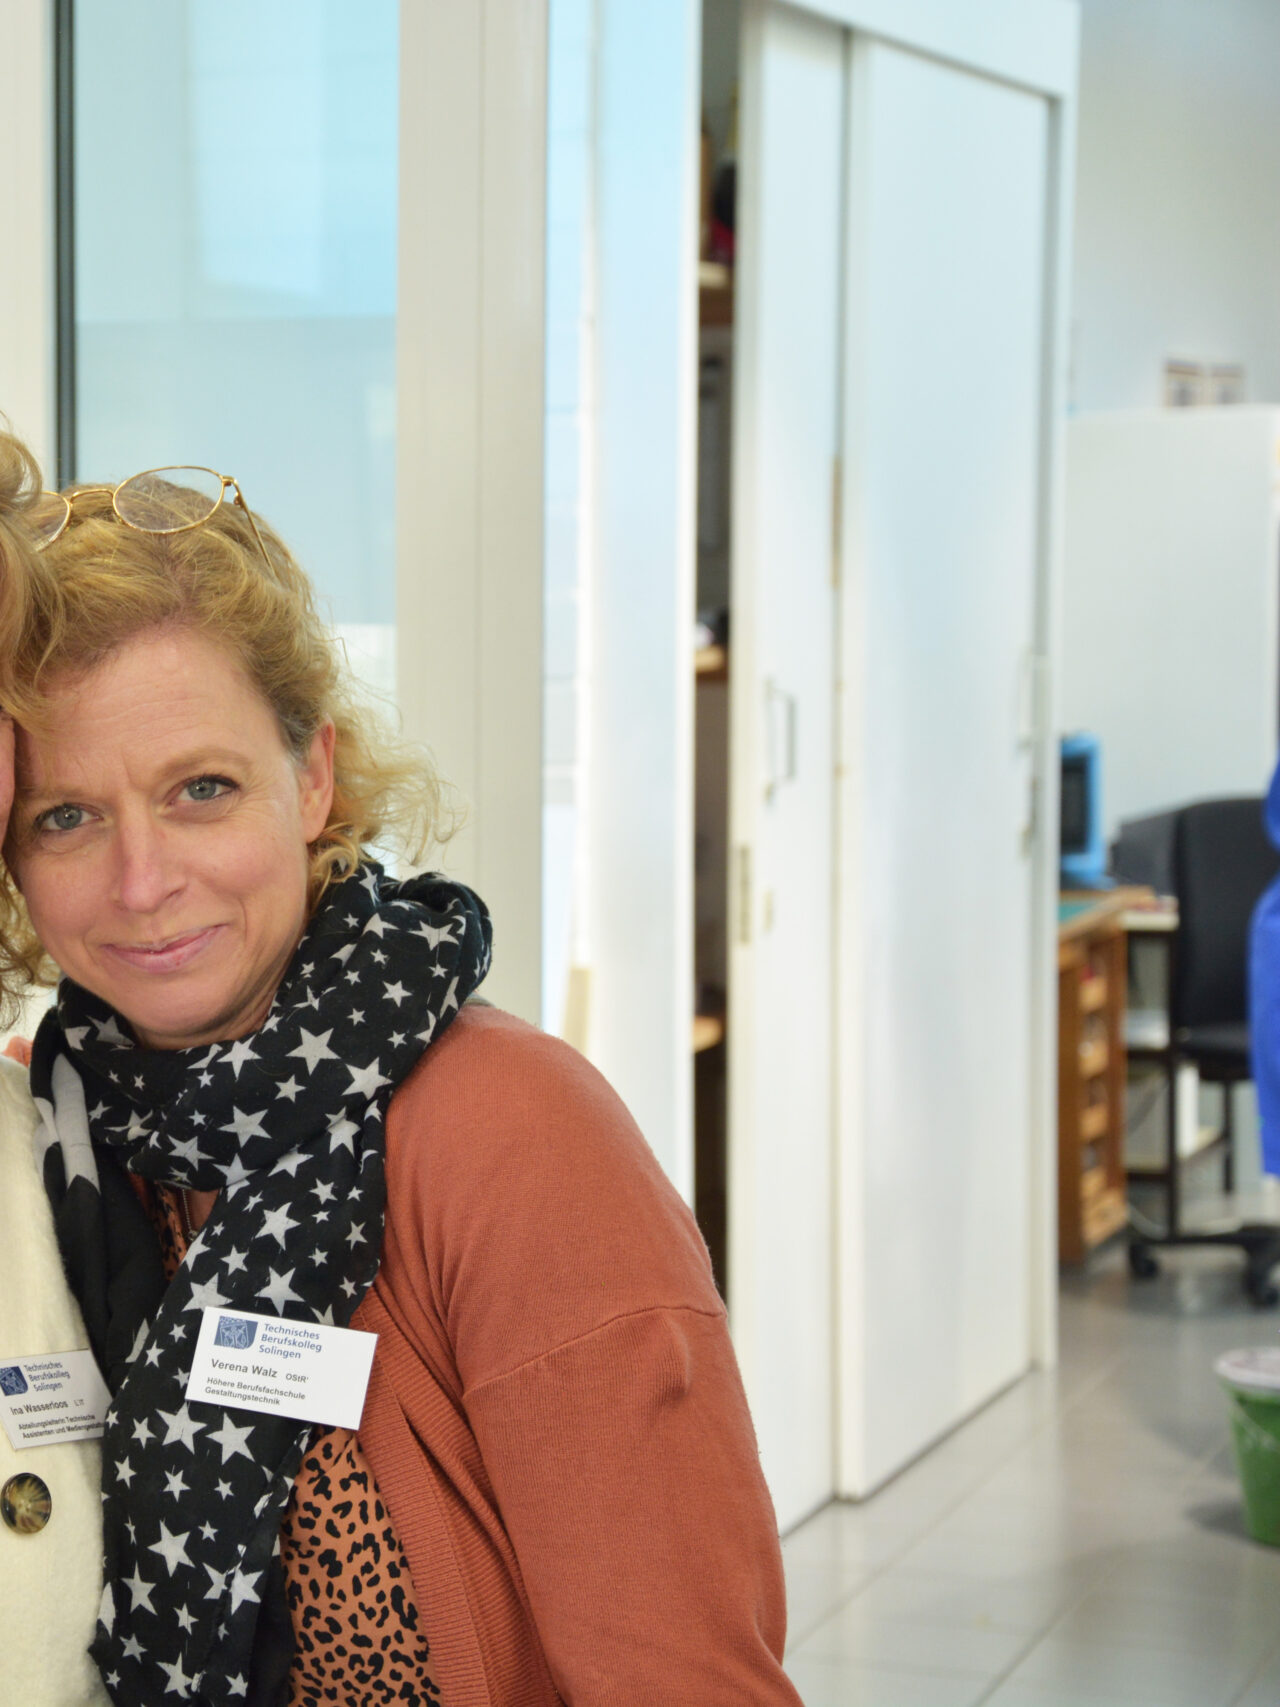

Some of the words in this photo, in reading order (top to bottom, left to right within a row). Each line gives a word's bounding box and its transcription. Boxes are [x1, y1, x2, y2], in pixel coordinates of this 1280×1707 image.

[264, 1323, 320, 1340] Technisches
[261, 1334, 322, 1352] Berufskolleg
[259, 1345, 302, 1360] Solingen
[24, 1362, 63, 1372] Technisches
[211, 1358, 248, 1373] Verena
[251, 1365, 278, 1378] Walz
[28, 1370, 71, 1382] Berufskolleg
[33, 1382, 63, 1392] Solingen
[207, 1377, 235, 1389] Höhere
[236, 1382, 306, 1400] Berufsfachschule
[205, 1387, 280, 1405] Gestaltungstechnik
[10, 1406, 24, 1415] Ina
